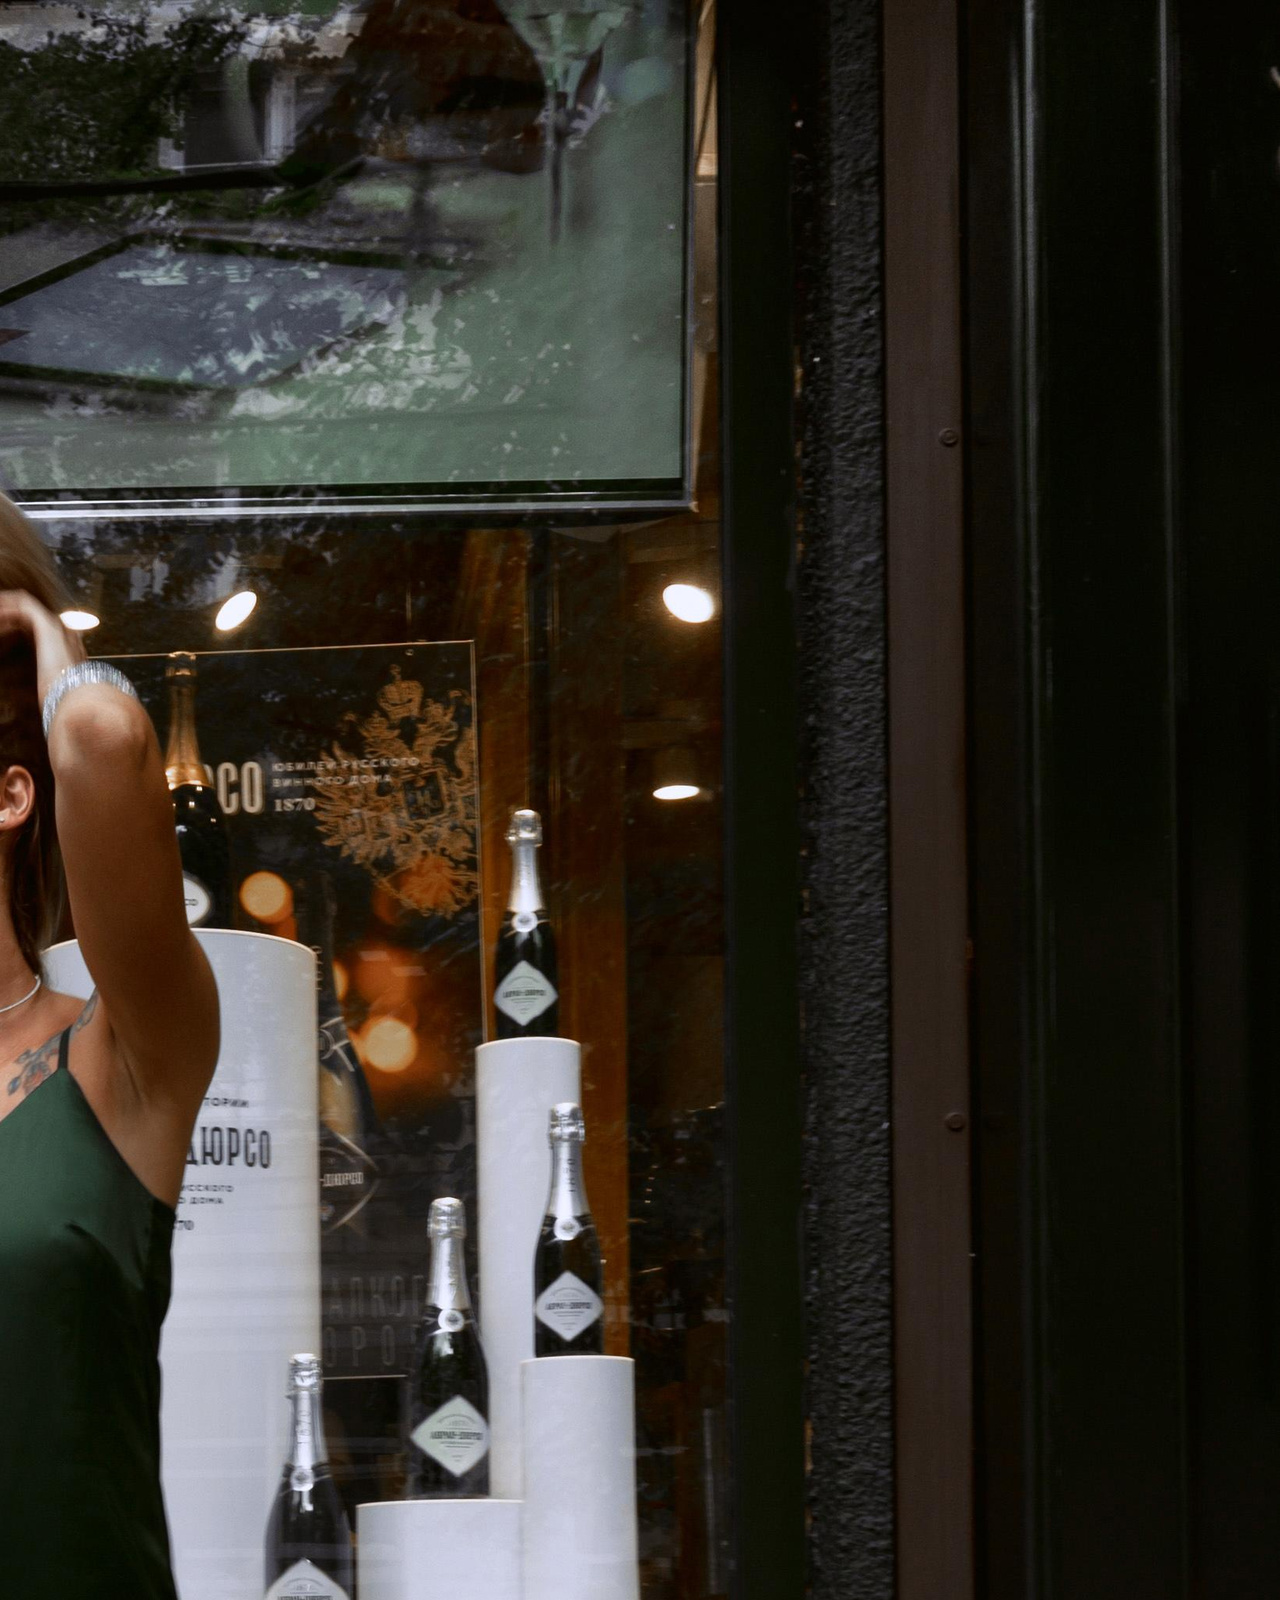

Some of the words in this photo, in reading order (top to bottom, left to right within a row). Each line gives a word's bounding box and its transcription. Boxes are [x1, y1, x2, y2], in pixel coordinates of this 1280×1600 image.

[348, 774, 393, 786] ДОМА
[206, 761, 264, 815] СО
[273, 797, 317, 812] 1870
